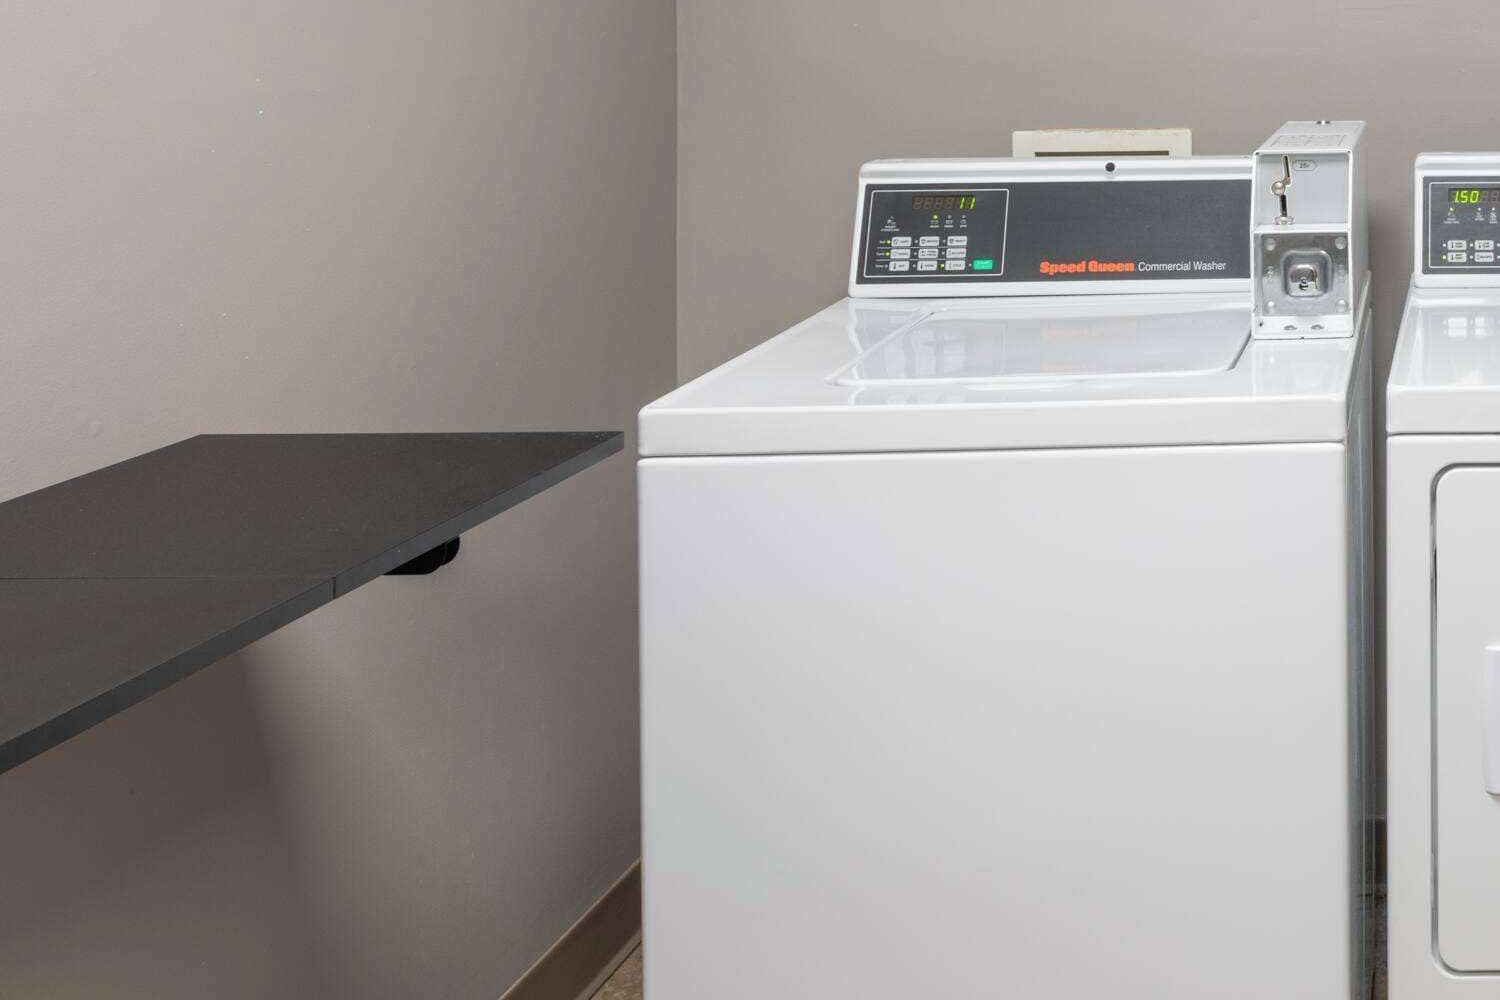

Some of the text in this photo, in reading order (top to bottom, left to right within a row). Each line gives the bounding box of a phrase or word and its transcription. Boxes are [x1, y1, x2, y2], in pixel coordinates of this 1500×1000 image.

[1039, 260, 1227, 275] Speed Queen Commercial Washer
